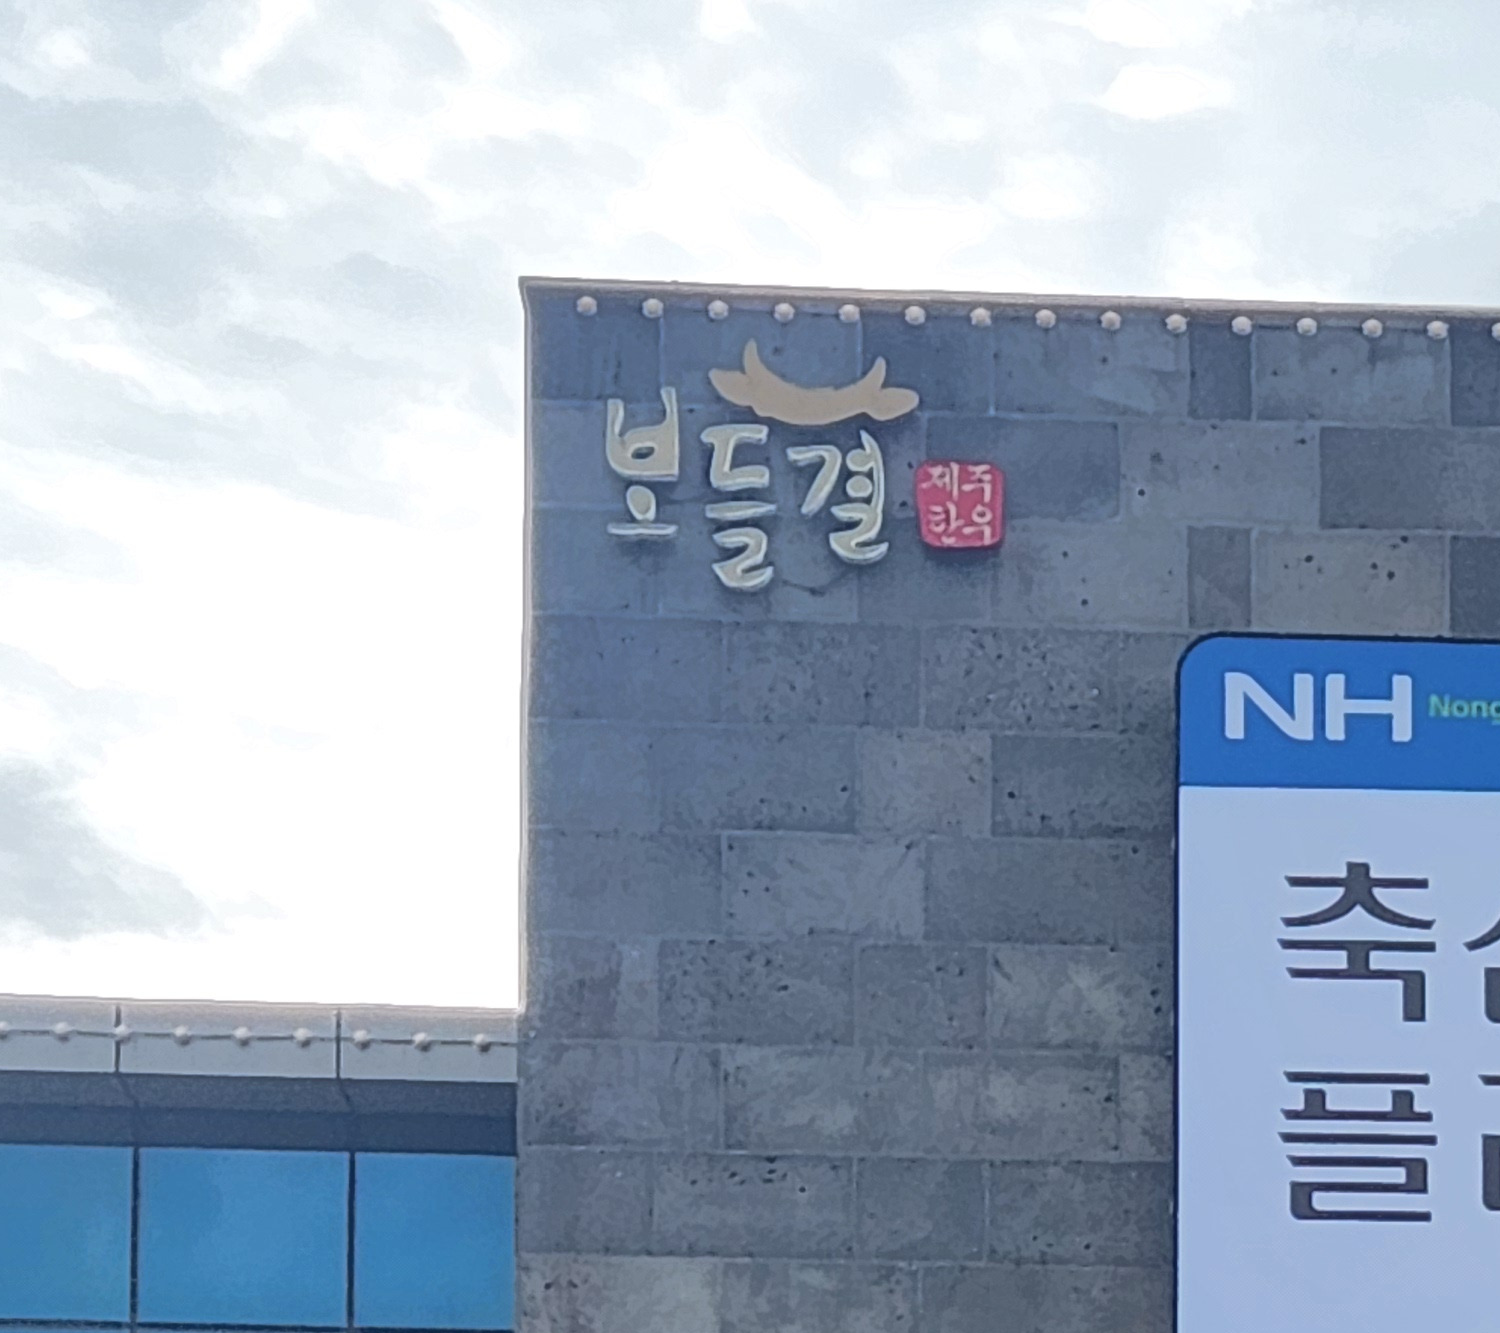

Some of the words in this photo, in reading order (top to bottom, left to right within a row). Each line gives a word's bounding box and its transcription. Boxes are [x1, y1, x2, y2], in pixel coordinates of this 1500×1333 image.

[920, 462, 992, 503] 제주
[928, 501, 992, 546] 한우
[1224, 671, 1413, 742] NH
